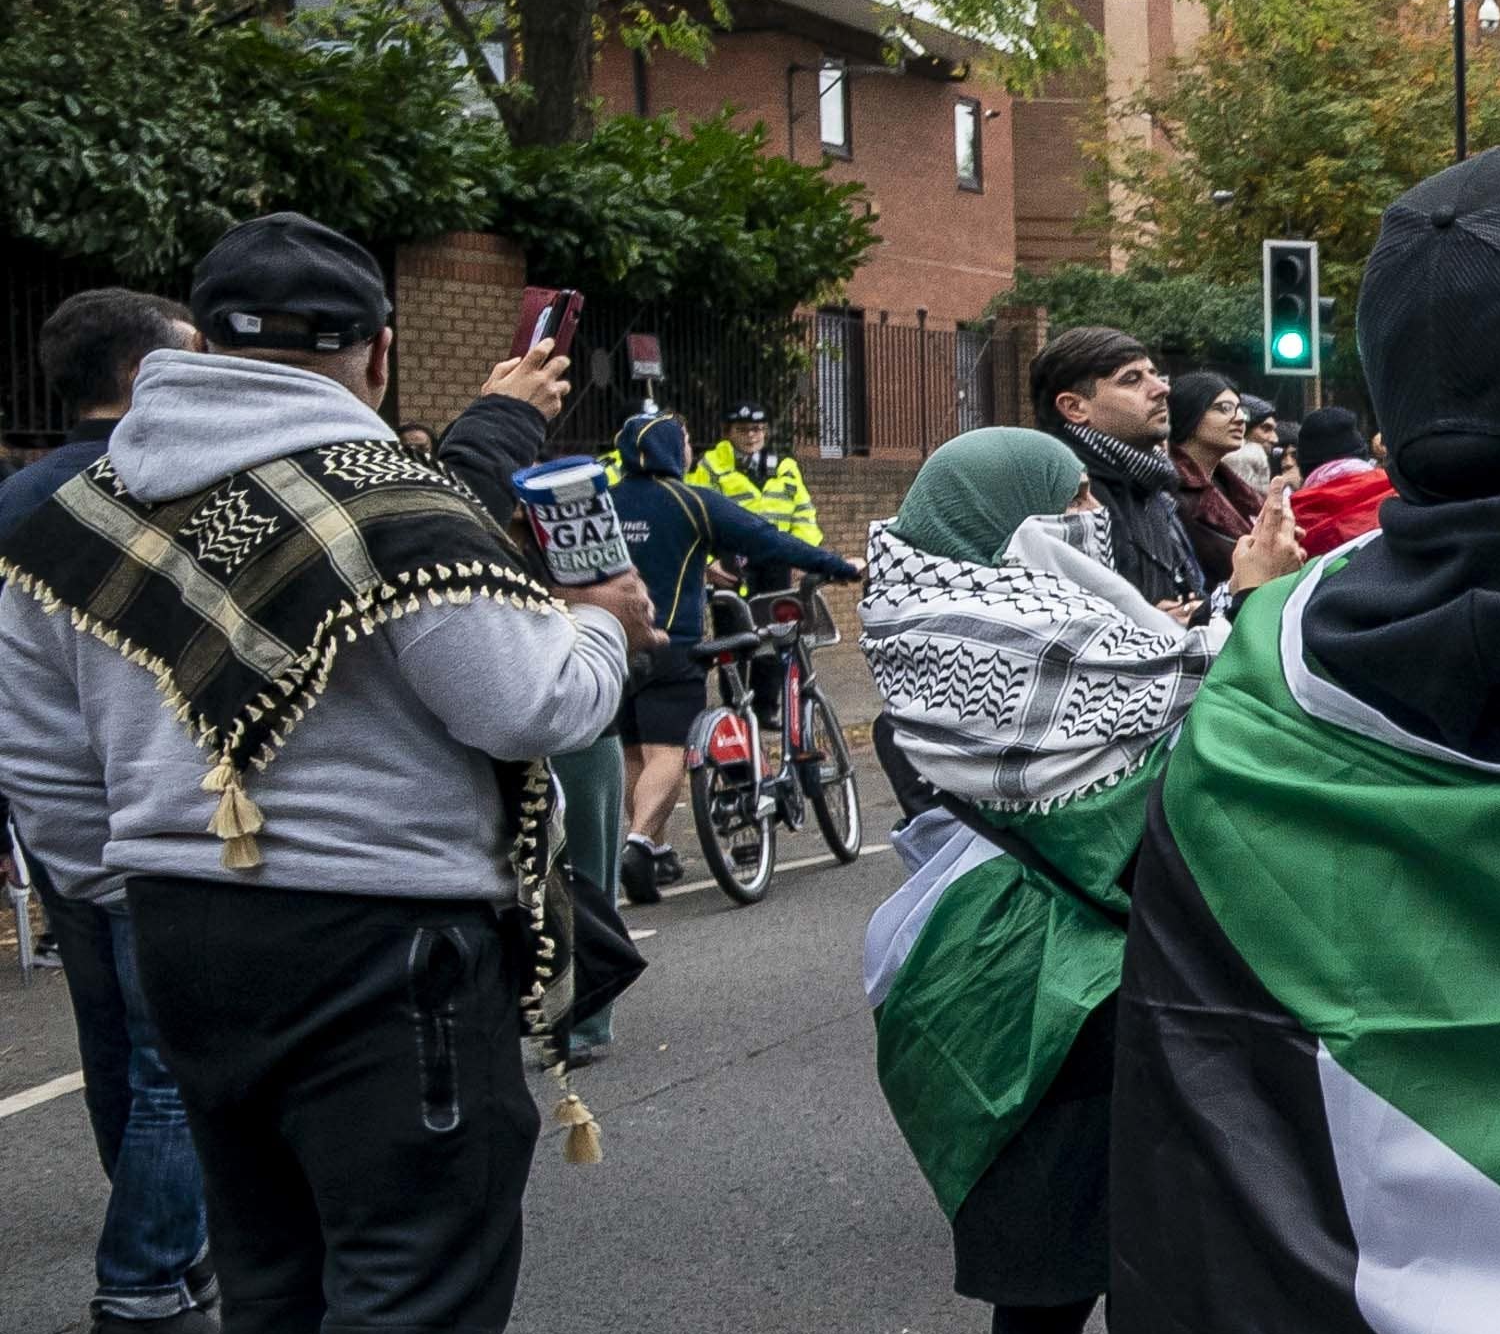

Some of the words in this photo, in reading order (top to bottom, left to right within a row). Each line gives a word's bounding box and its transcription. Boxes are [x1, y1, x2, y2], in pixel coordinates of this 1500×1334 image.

[533, 501, 593, 521] STOP
[552, 516, 620, 550] GAZ
[549, 539, 628, 572] GENOCI
